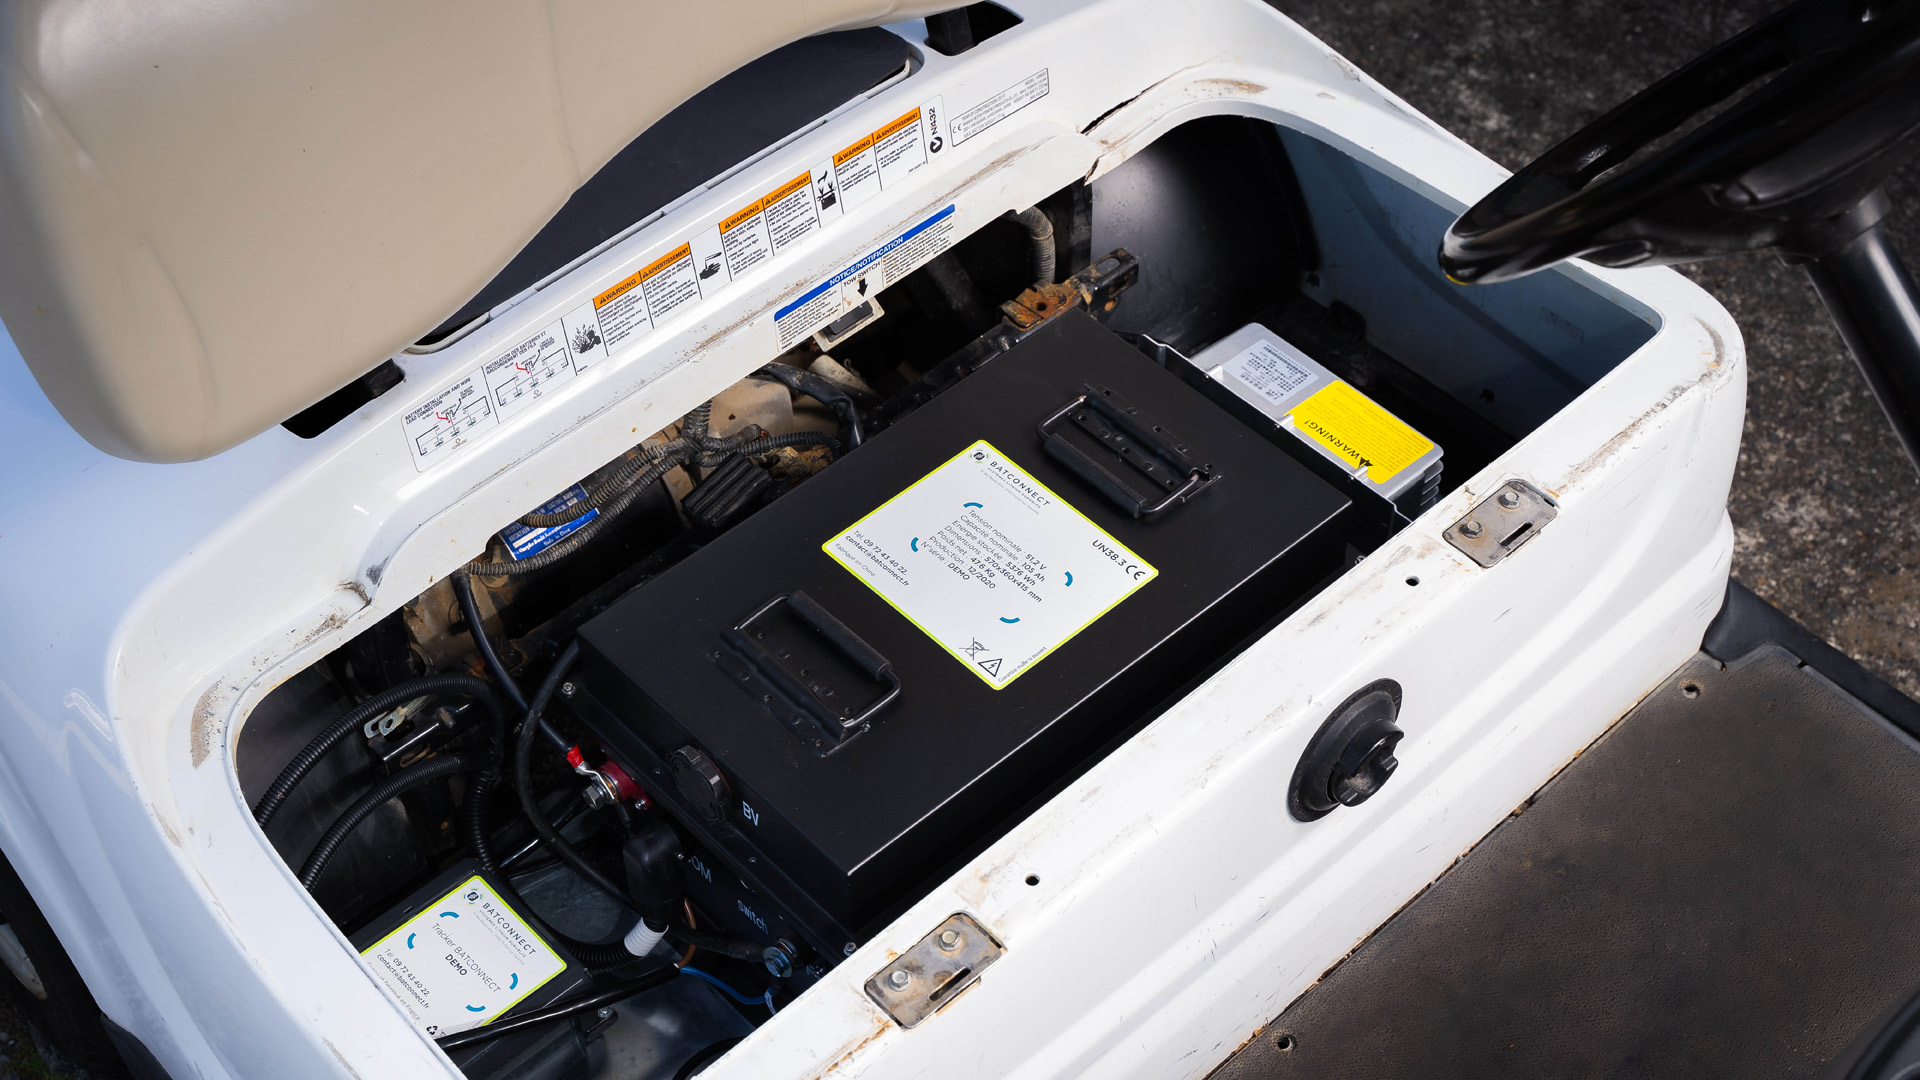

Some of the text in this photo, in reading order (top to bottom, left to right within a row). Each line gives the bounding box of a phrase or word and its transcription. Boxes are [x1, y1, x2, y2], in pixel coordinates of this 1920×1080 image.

[842, 139, 871, 159] WARNING
[771, 176, 809, 202] ADVERTISSEMENT
[730, 205, 759, 225] WARNING
[648, 247, 688, 275] ADVERTISSEMENT
[829, 236, 903, 286] NOTICE/NOTIFICATION
[843, 261, 880, 287] TOW SWITCH
[605, 279, 636, 300] WARNING
[405, 407, 423, 421] BATTERY
[1304, 421, 1360, 459] WARNING!
[990, 461, 1050, 506] BATCONNECT
[1092, 539, 1127, 566] UN38.3
[863, 539, 874, 547] 09
[873, 545, 882, 554] 72
[960, 515, 989, 538] Capacité
[988, 537, 1018, 561] nominale
[1021, 562, 1035, 573] 105
[1033, 573, 1045, 582] Ah
[968, 509, 993, 530] Tension
[992, 529, 1022, 553] nominale
[1025, 553, 1040, 566] 51,2
[845, 535, 909, 586] contact@batconnect.fr
[928, 535, 964, 565] Production
[967, 566, 996, 589] 12/2020
[937, 530, 956, 546] Poids
[955, 545, 967, 556] net
[984, 568, 995, 578] Kg
[944, 525, 981, 555] Dimensions
[984, 556, 1029, 592] 570x360x415
[1027, 591, 1042, 603] mm
[977, 540, 1003, 560] stockée
[1005, 561, 1024, 576] 5376
[1023, 574, 1036, 586] Wh
[947, 562, 970, 580] DEMO
[742, 800, 760, 827] BV
[688, 855, 712, 883] OM
[482, 902, 536, 955] BATCONNECT
[737, 898, 768, 935] switch
[393, 958, 402, 967] 09
[400, 965, 409, 974] 72
[407, 973, 416, 981] 43
[432, 922, 456, 947] Tracker
[454, 946, 501, 992] BATCONNECT
[445, 954, 467, 976] DEMO
[377, 954, 429, 1009] contact@batconnect.fr
[405, 1004, 420, 1020] France
